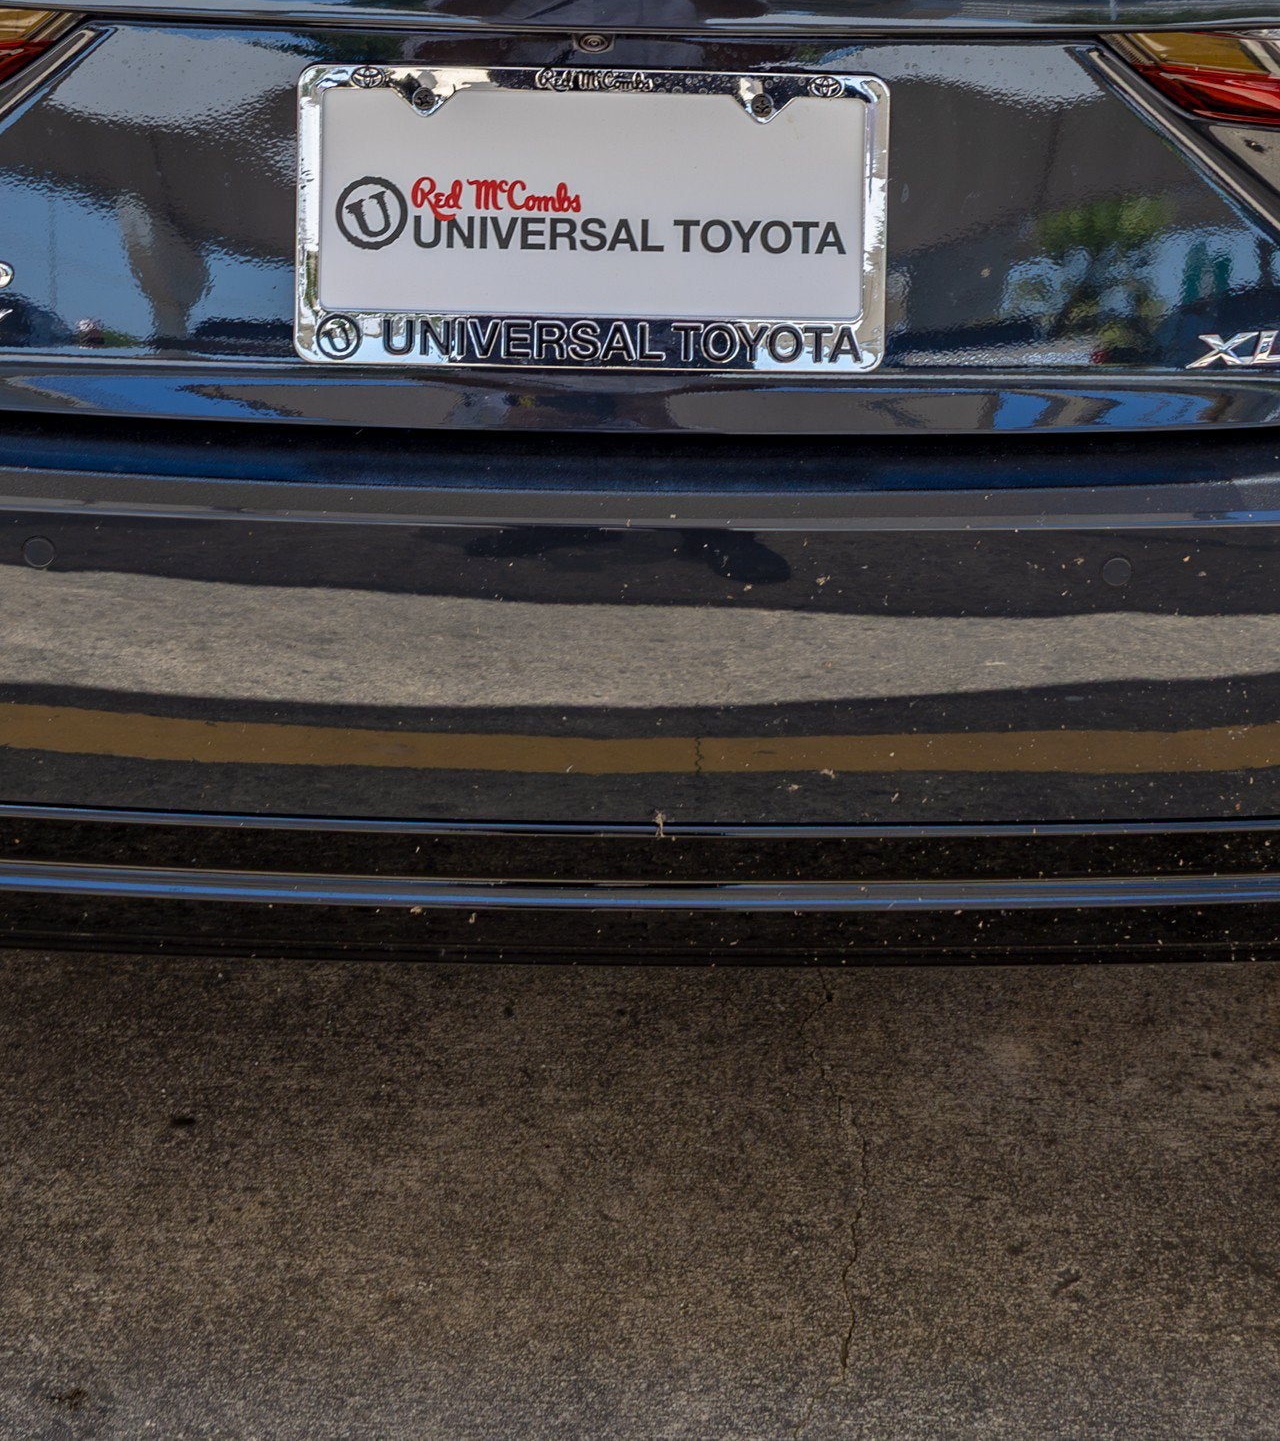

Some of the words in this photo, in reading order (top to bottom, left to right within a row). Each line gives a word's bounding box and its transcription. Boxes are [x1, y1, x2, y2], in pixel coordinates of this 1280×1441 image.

[535, 67, 575, 92] Red
[411, 176, 463, 222] Red
[466, 178, 582, 213] McCombs
[413, 214, 664, 253] UNIVERSAL
[673, 219, 847, 255] TOYOTA
[382, 317, 666, 362] UNIVERSAL
[670, 321, 865, 365] TOYOTA
